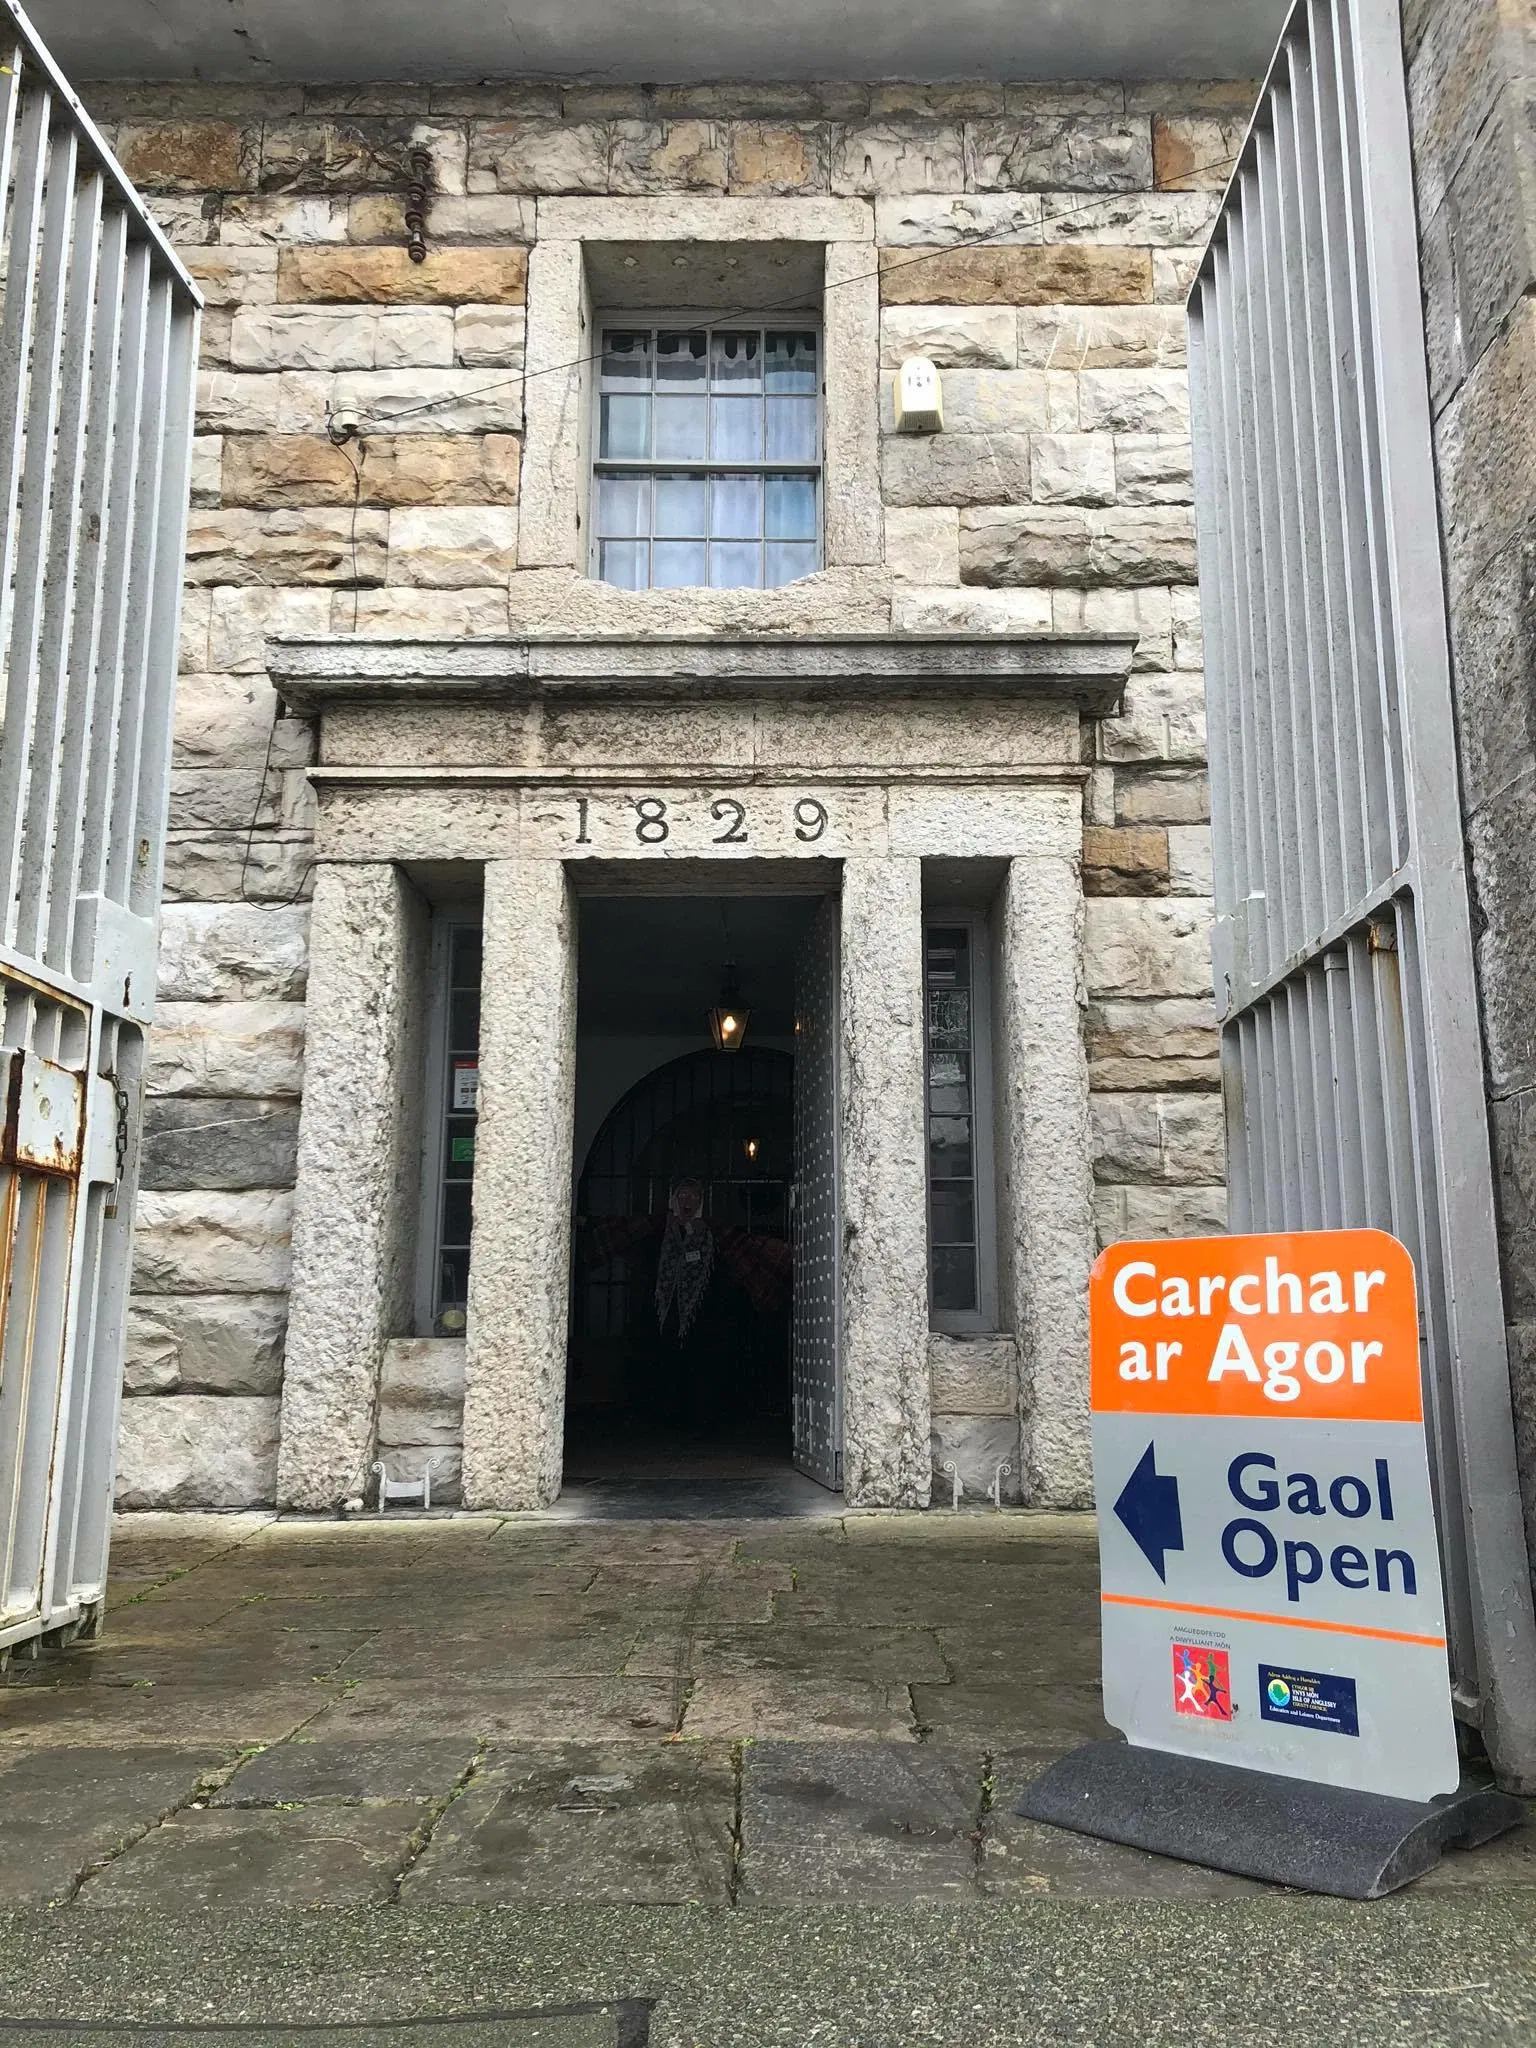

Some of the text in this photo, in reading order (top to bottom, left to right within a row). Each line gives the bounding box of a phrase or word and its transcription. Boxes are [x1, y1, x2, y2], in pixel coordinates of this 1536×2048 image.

[575, 797, 829, 843] 1829
[1113, 1256, 1386, 1317] Carchar
[1119, 1323, 1383, 1401] ar Agor
[1227, 1452, 1394, 1521] Gaol
[1221, 1517, 1417, 1602] Open
[1311, 1699, 1337, 1708] ANGLESEY
